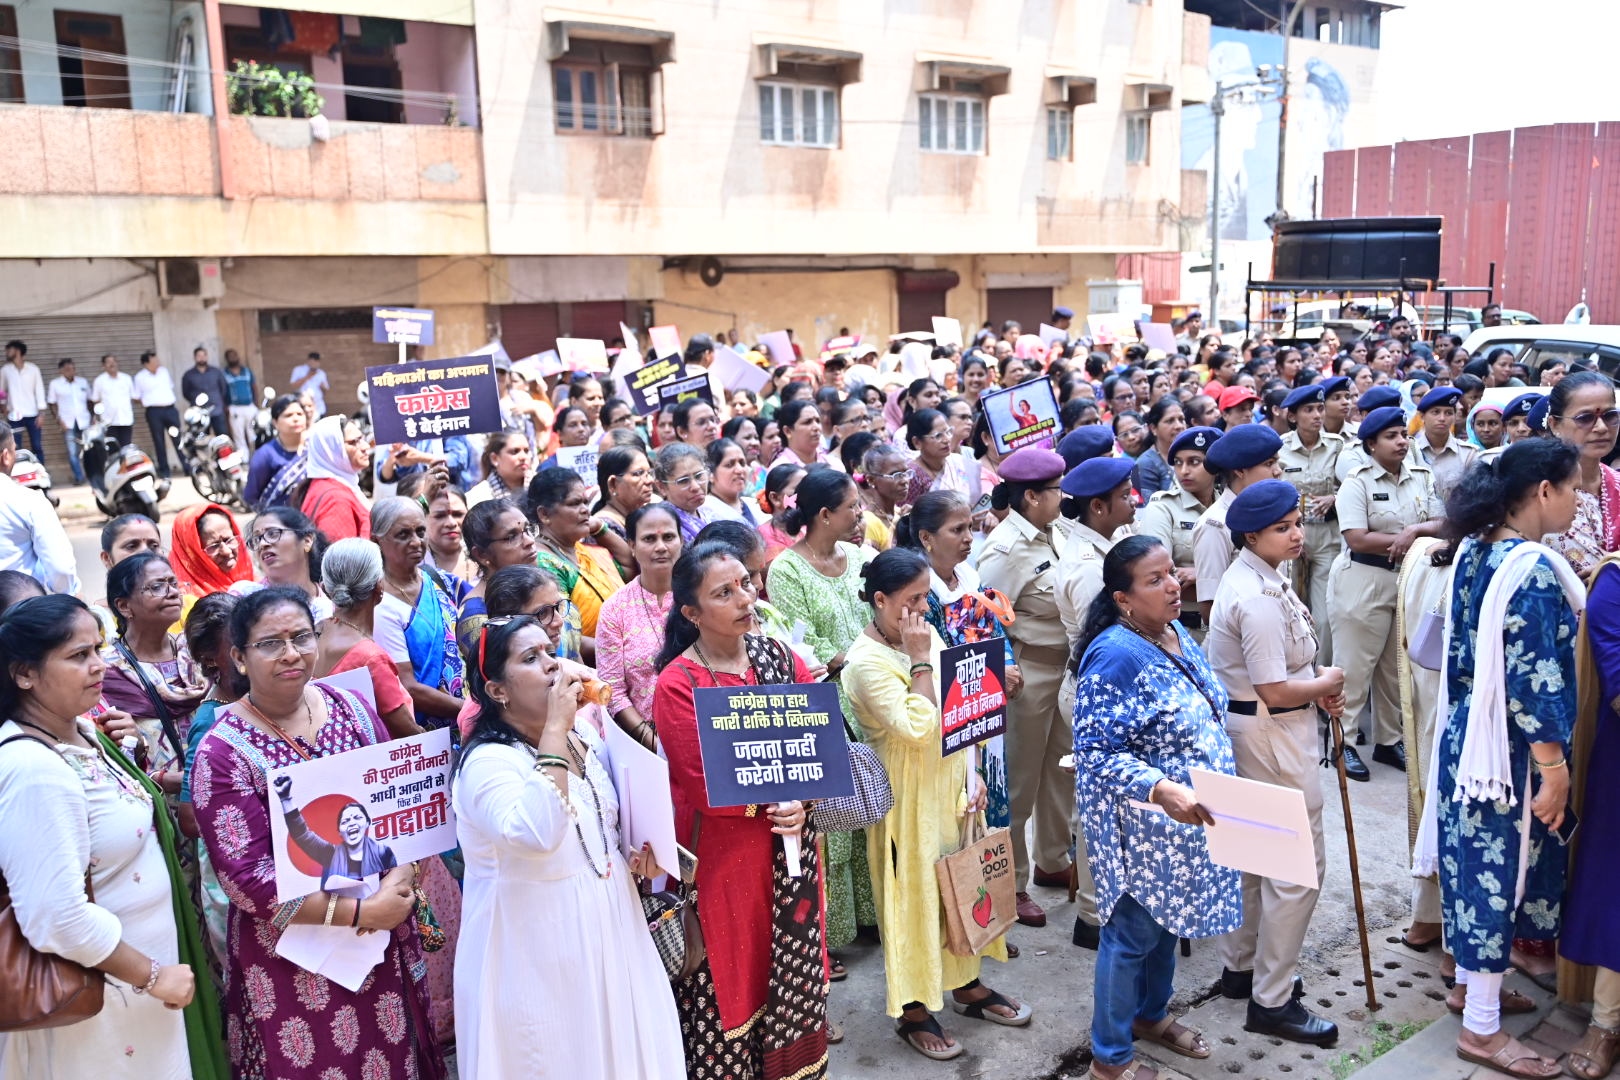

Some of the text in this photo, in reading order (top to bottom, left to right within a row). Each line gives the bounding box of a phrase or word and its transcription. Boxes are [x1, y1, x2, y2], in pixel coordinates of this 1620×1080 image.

[372, 364, 489, 387] महिलाओं का अपमान
[394, 385, 470, 415] कांग्रेस
[405, 417, 417, 437] है
[955, 649, 986, 685] कांग्रेस
[728, 692, 809, 711] कांग्रेस का हाथ
[961, 680, 969, 698] का
[711, 709, 829, 730] नारी शक्ति के खिलाफ
[944, 691, 1003, 727] नारी शक्ति के खिलाफ
[733, 733, 816, 760] जनता नहीं
[945, 730, 960, 750] जनता
[960, 723, 972, 742] नहीं
[972, 717, 986, 738] करेगी
[389, 743, 422, 762] कांग्रेस
[362, 750, 449, 785] की पुरानी बीमारी
[735, 760, 824, 786] करेगी माफ
[370, 773, 445, 803] आधी आबादी से
[397, 793, 422, 809] फिर की
[371, 791, 448, 841] गद्दारी
[982, 858, 1008, 877] FOOD
